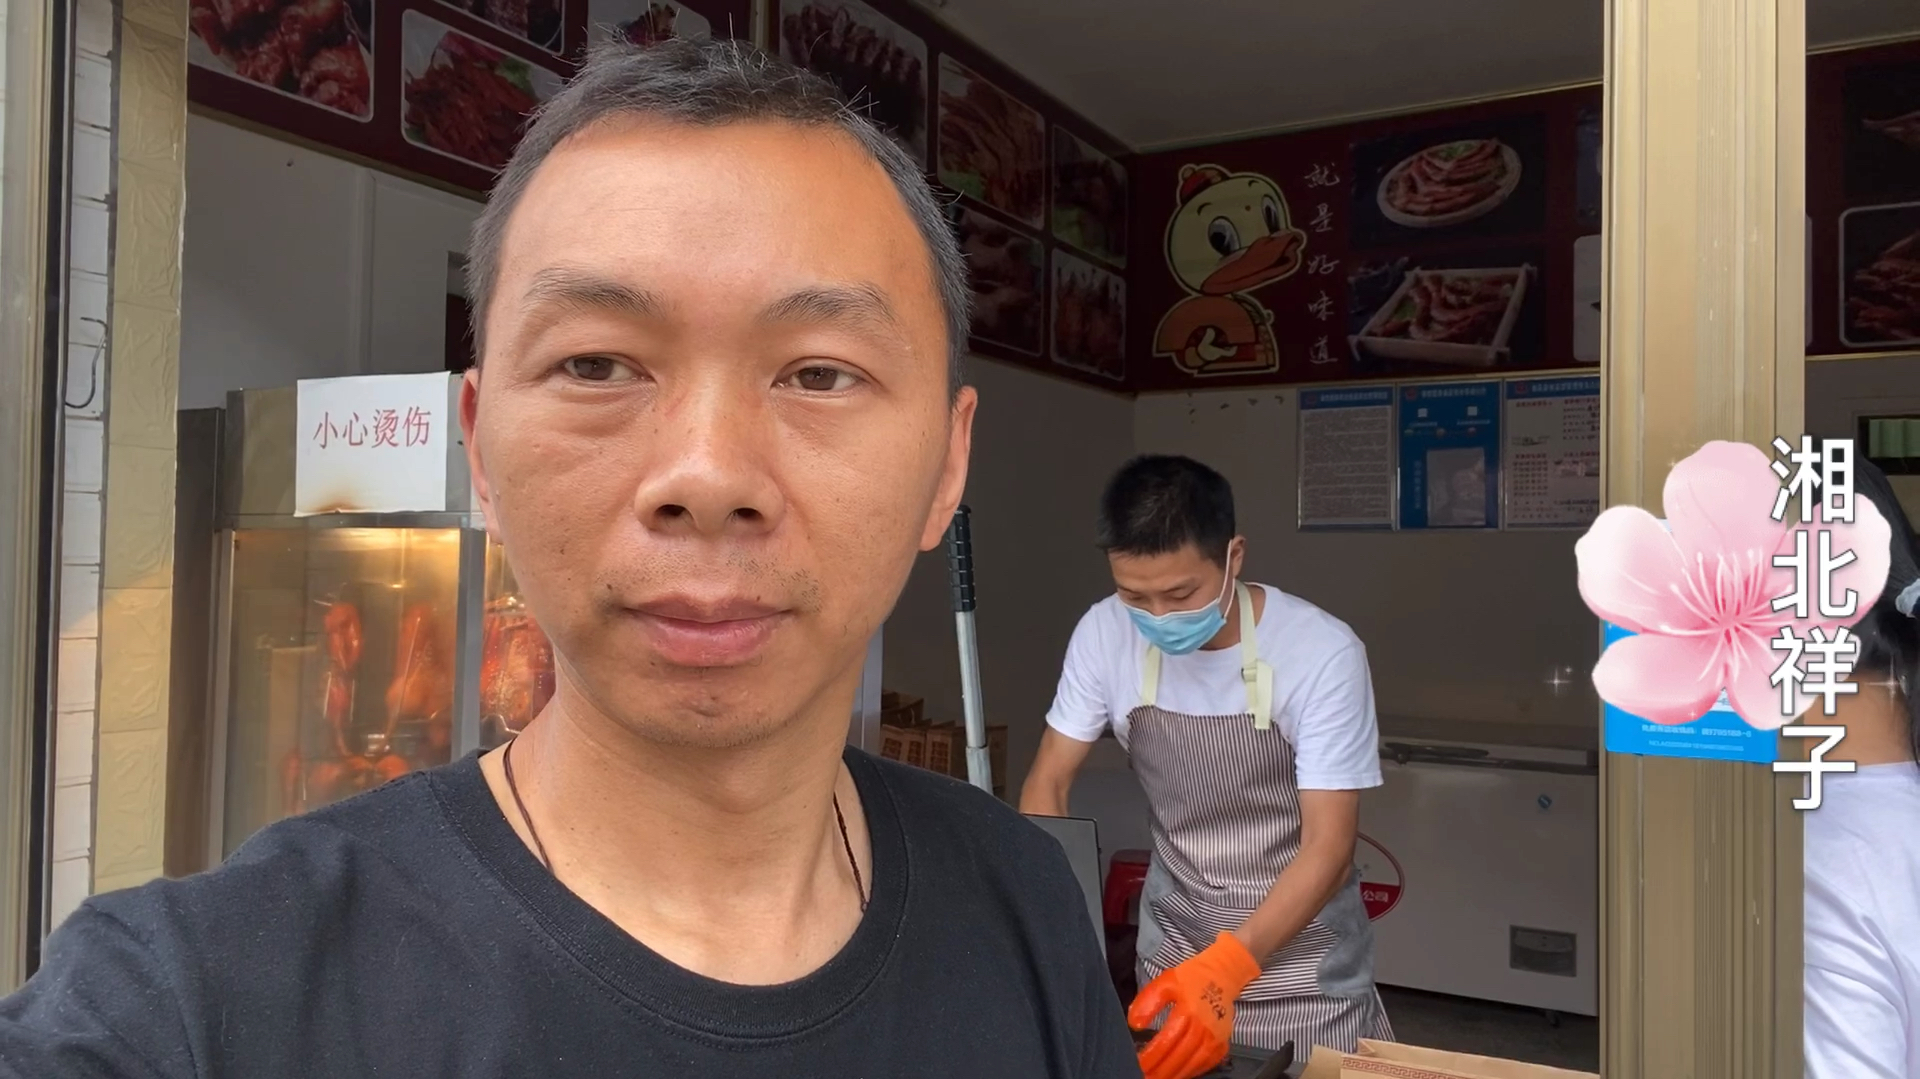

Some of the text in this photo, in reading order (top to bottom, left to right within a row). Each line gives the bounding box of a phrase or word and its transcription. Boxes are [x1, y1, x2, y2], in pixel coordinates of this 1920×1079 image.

[1304, 162, 1341, 365] 就是好味道
[312, 405, 432, 450] 小心烫伤
[1362, 889, 1389, 903] 公司
